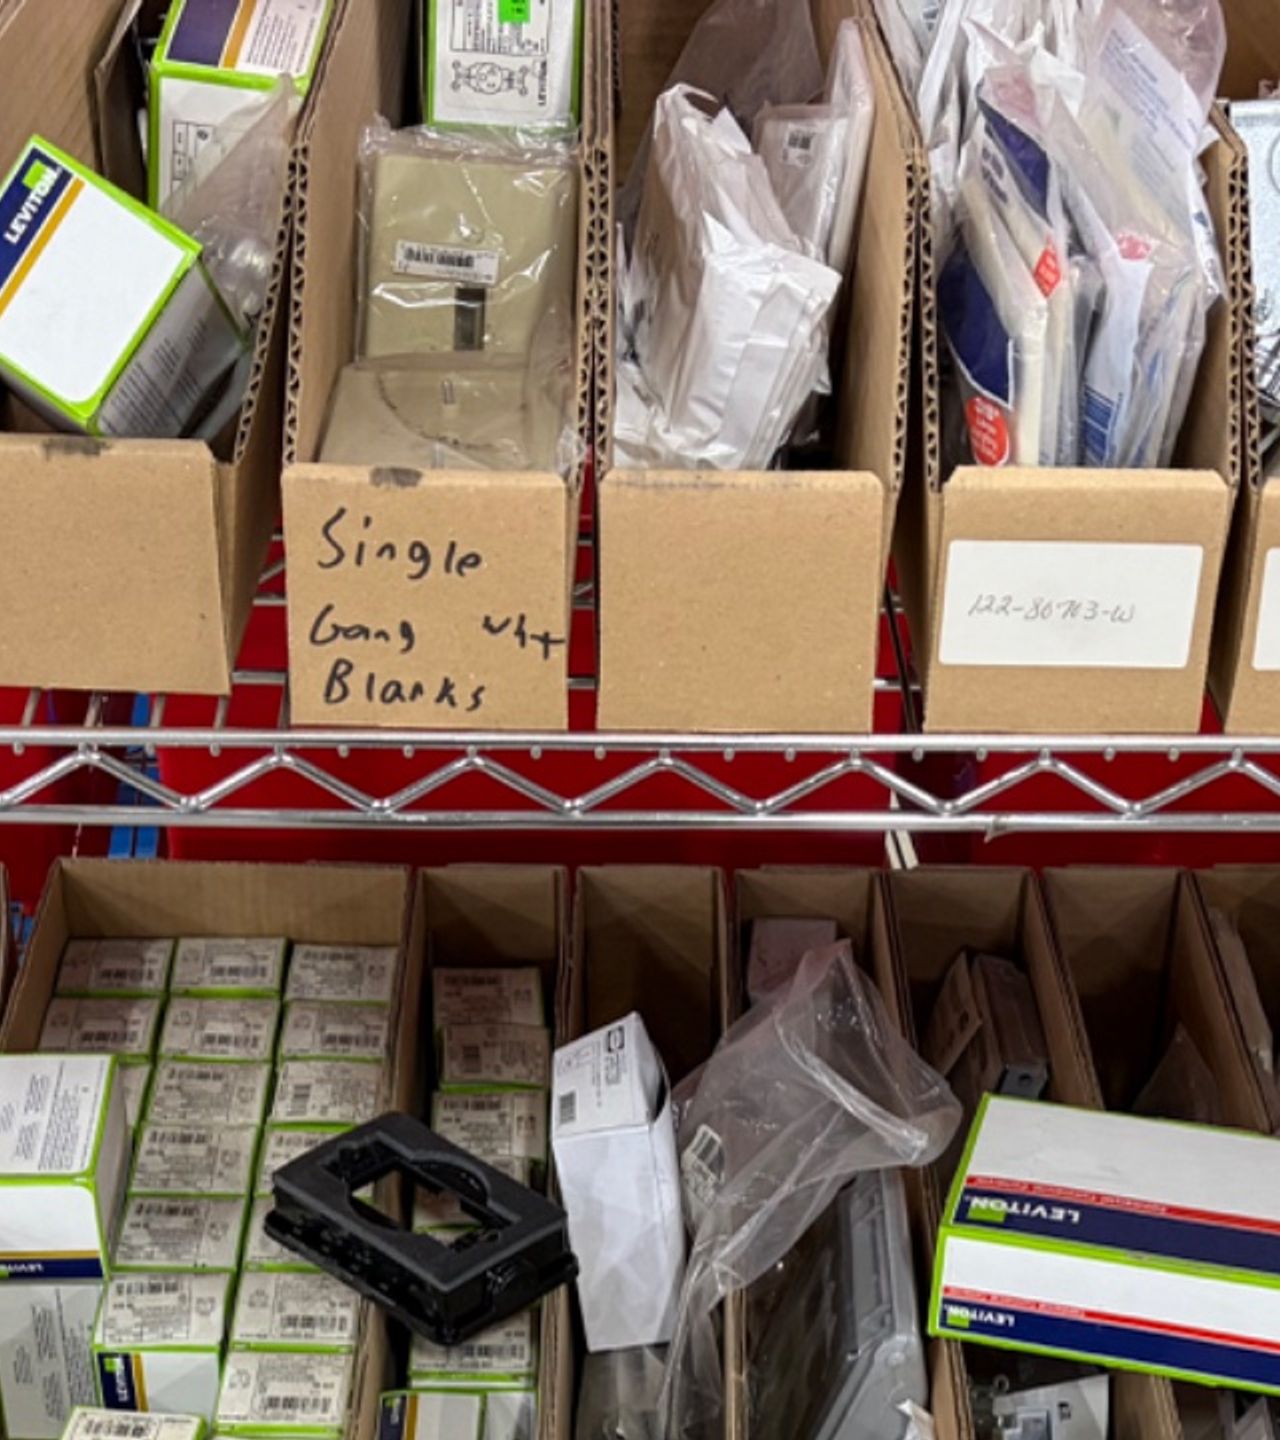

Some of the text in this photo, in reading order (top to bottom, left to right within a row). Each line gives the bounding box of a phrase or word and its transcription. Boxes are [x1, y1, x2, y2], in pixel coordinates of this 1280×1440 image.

[3, 166, 62, 245] LEVITON
[317, 507, 482, 579] Single
[309, 603, 415, 654] Gang
[324, 658, 486, 712] Blanks
[966, 1196, 1080, 1224] LEVITON
[945, 1303, 1015, 1327] LEVITON
